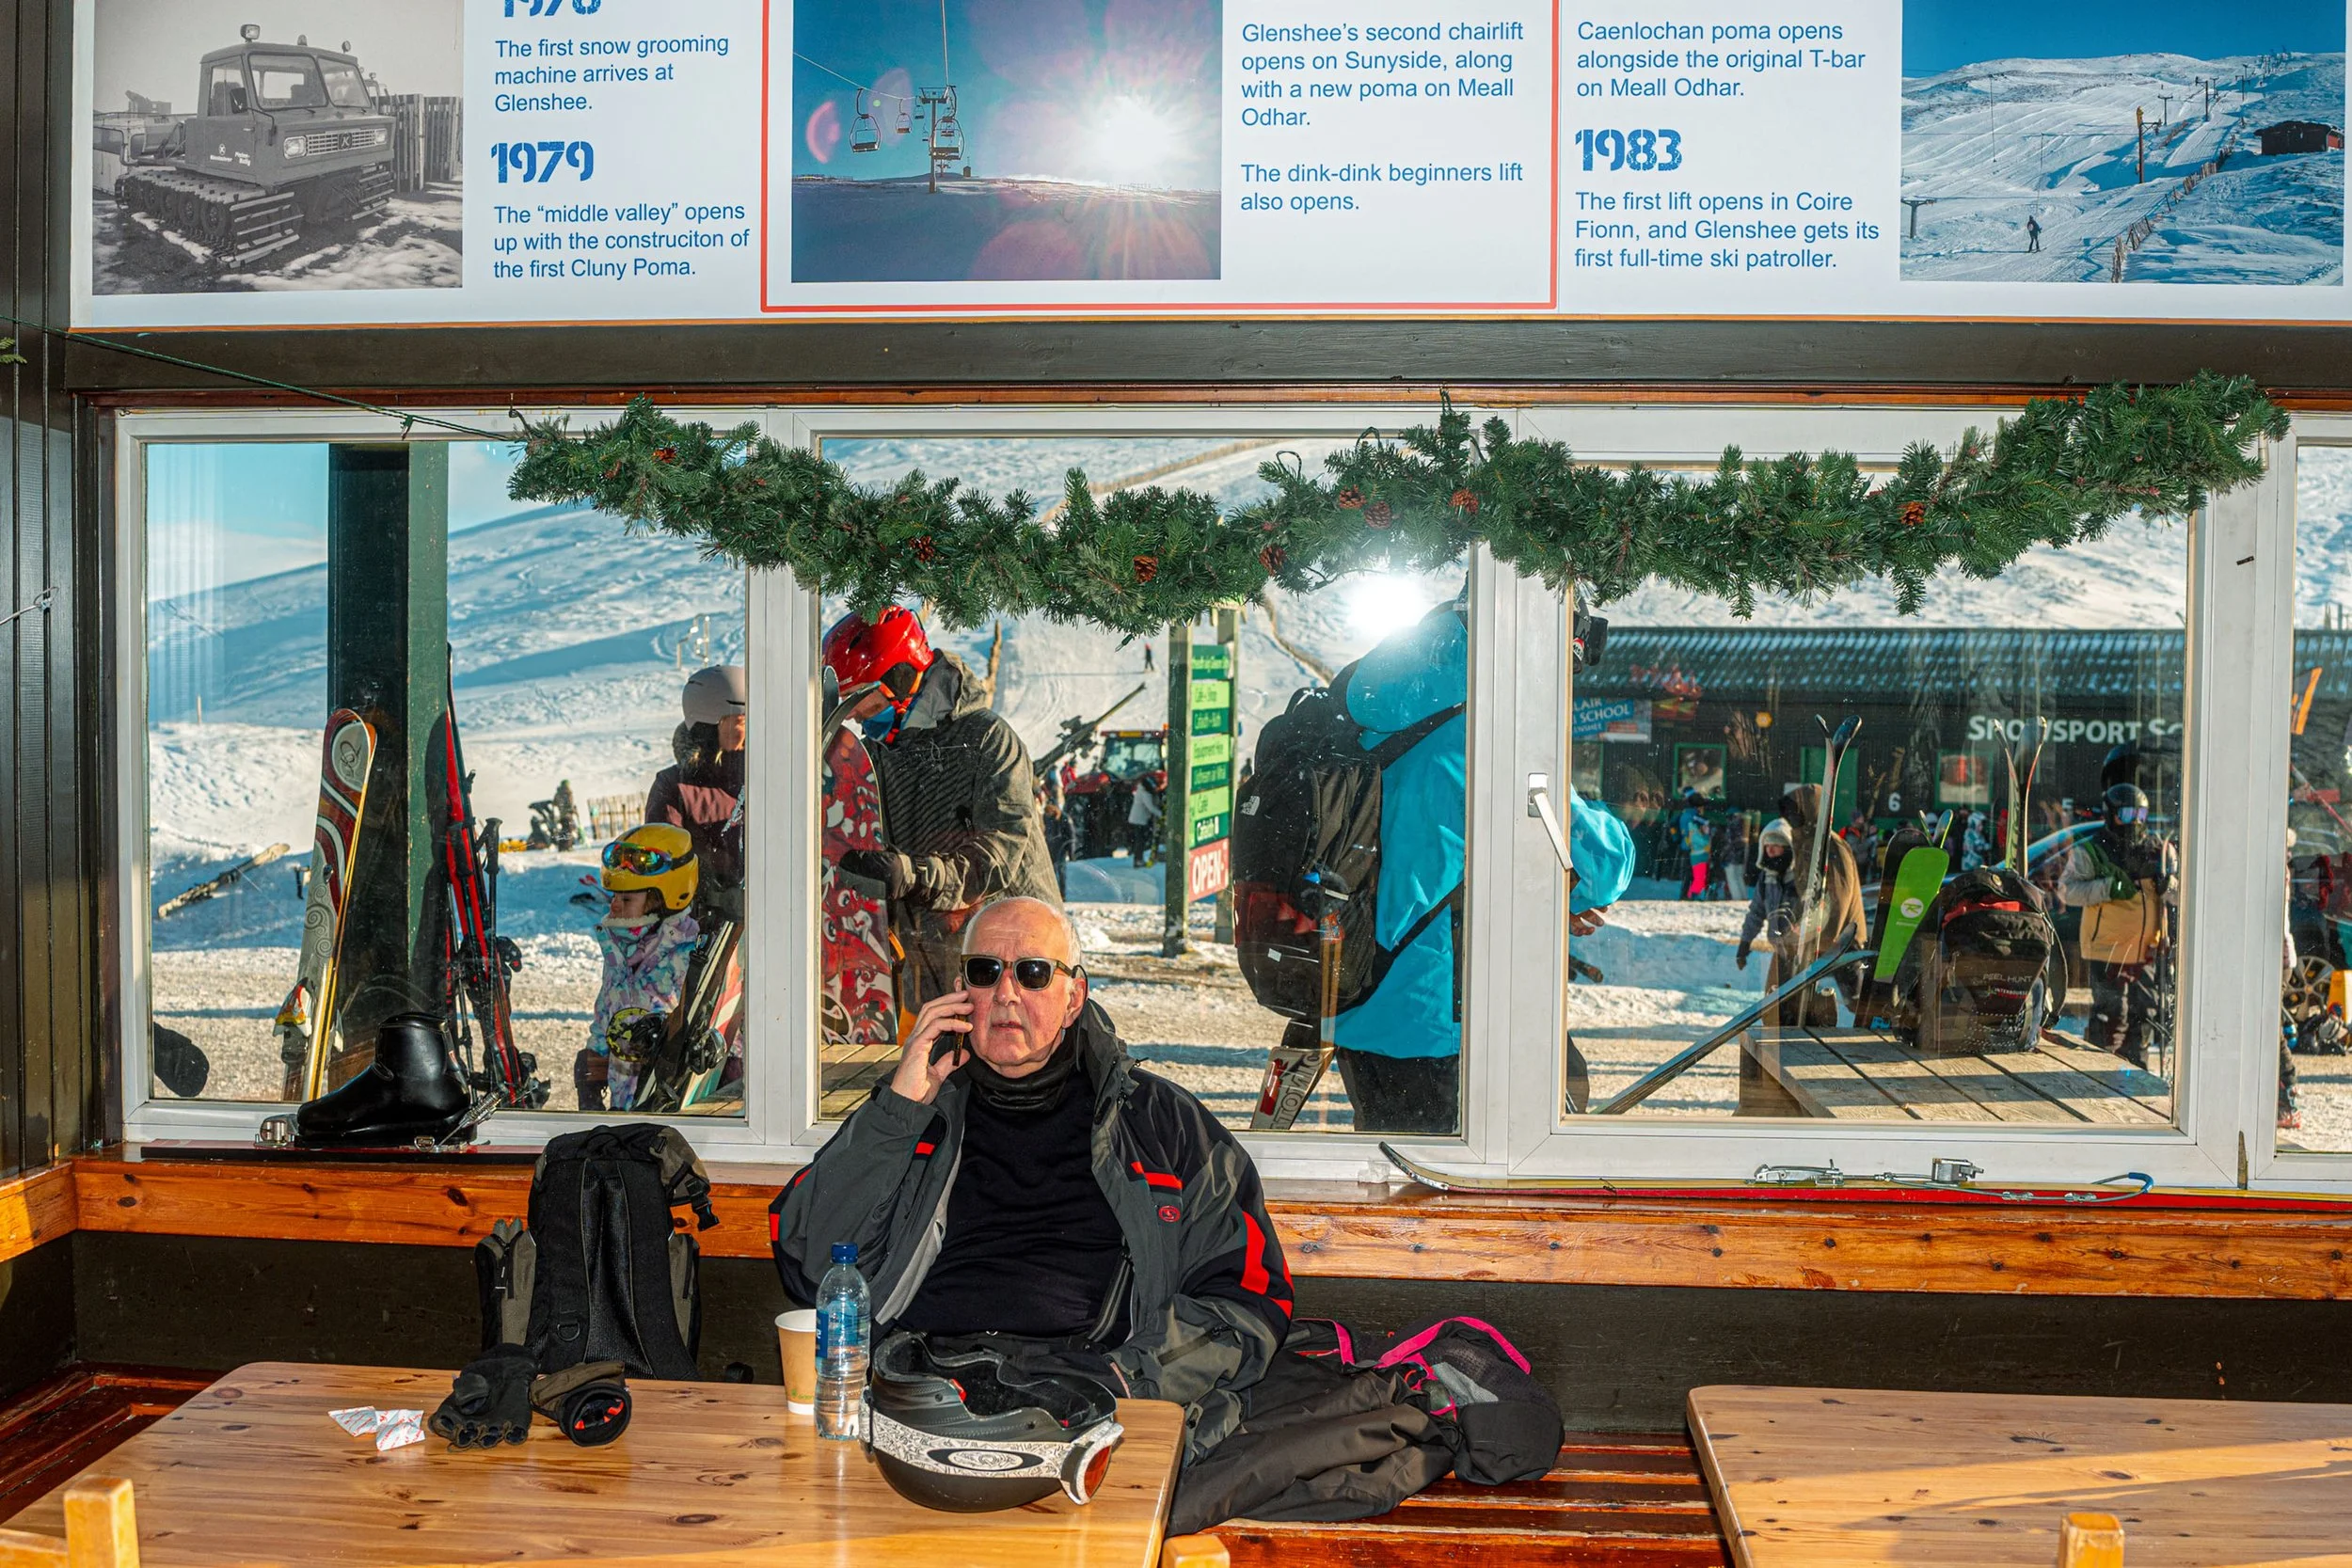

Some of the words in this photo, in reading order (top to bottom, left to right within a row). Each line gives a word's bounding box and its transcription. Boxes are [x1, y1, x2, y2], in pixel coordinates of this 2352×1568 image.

[1242, 23, 1359, 41] Glenshee’s
[1365, 22, 1440, 40] second
[1448, 21, 1523, 40] chairlift
[1578, 21, 1703, 40] Caenlochan
[1711, 24, 1770, 43] poma
[1778, 24, 1842, 43] opens
[494, 40, 532, 57] The
[537, 38, 573, 55] first
[580, 40, 630, 55] snow
[636, 34, 728, 58] grooming
[1241, 55, 1305, 74] opens
[1311, 55, 1337, 70] on
[1344, 50, 1446, 73] Sunyside,
[1454, 50, 1512, 72] along
[1577, 49, 1678, 72] alongside
[1685, 49, 1718, 68] the
[1725, 49, 1802, 72] original
[1808, 49, 1866, 68] T-bar
[495, 65, 576, 85] machine
[582, 63, 648, 82] arrives
[655, 63, 673, 80] at
[1241, 79, 1281, 98] with
[1289, 84, 1301, 98] a
[1310, 83, 1352, 97] new
[1359, 82, 1417, 102] poma
[1424, 82, 1450, 96] on
[1458, 77, 1513, 96] Meall
[1577, 82, 1602, 96] on
[1611, 77, 1665, 96] Meall
[1674, 77, 1743, 96] Odhar.
[494, 92, 592, 112] Glenshee.
[1241, 107, 1310, 126] Odhar.
[1575, 128, 1682, 171] 1983
[490, 140, 594, 183] 1979
[1240, 164, 1280, 182] The
[1287, 163, 1381, 182] dink-dink
[1389, 163, 1491, 185] beginners
[1499, 162, 1522, 181] lift
[493, 205, 531, 223] The
[537, 203, 608, 222] “middle
[614, 202, 677, 225] valley”
[684, 205, 744, 224] opens
[1240, 192, 1282, 210] also
[1290, 195, 1359, 214] opens.
[1575, 191, 1615, 210] The
[1622, 191, 1661, 210] first
[1668, 191, 1692, 210] lift
[1698, 196, 1763, 214] opens
[1771, 191, 1788, 210] in
[1796, 191, 1852, 211] Coire
[494, 236, 516, 255] up
[523, 231, 561, 249] with
[568, 231, 598, 249] the
[605, 230, 723, 248] construciton
[730, 228, 750, 246] of
[1576, 219, 1639, 241] Fionn,
[1647, 219, 1686, 238] and
[1694, 219, 1796, 239] Glenshee
[1803, 221, 1848, 243] gets
[1856, 220, 1879, 239] its
[493, 260, 523, 277] the
[529, 259, 564, 277] first
[571, 258, 627, 280] Cluny
[633, 258, 695, 276] Poma.
[1574, 247, 1613, 266] first
[1619, 247, 1703, 266] full-time
[1709, 247, 1738, 267] ski
[1746, 248, 1836, 271] patroller.
[1580, 704, 1630, 723] SCHOOL
[1888, 792, 1900, 812] 6
[1192, 851, 1222, 895] OPEN
